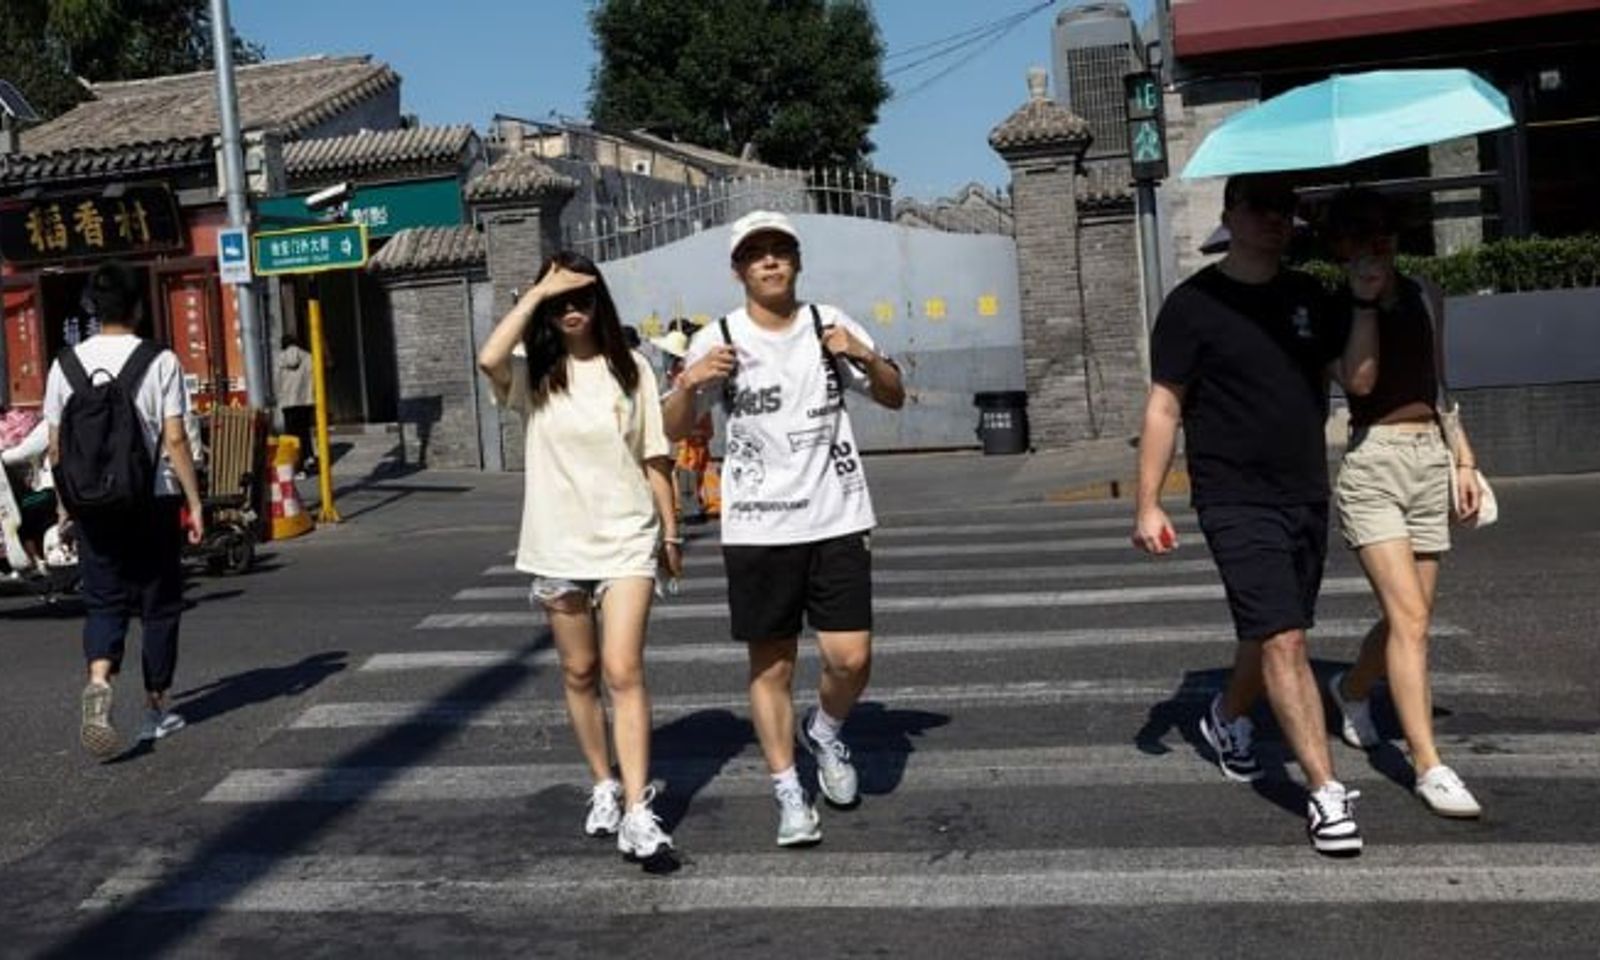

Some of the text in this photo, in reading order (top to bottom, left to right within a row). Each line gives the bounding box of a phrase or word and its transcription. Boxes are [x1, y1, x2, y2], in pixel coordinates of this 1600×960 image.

[25, 200, 149, 251] 稻香村
[829, 441, 857, 476] 22
